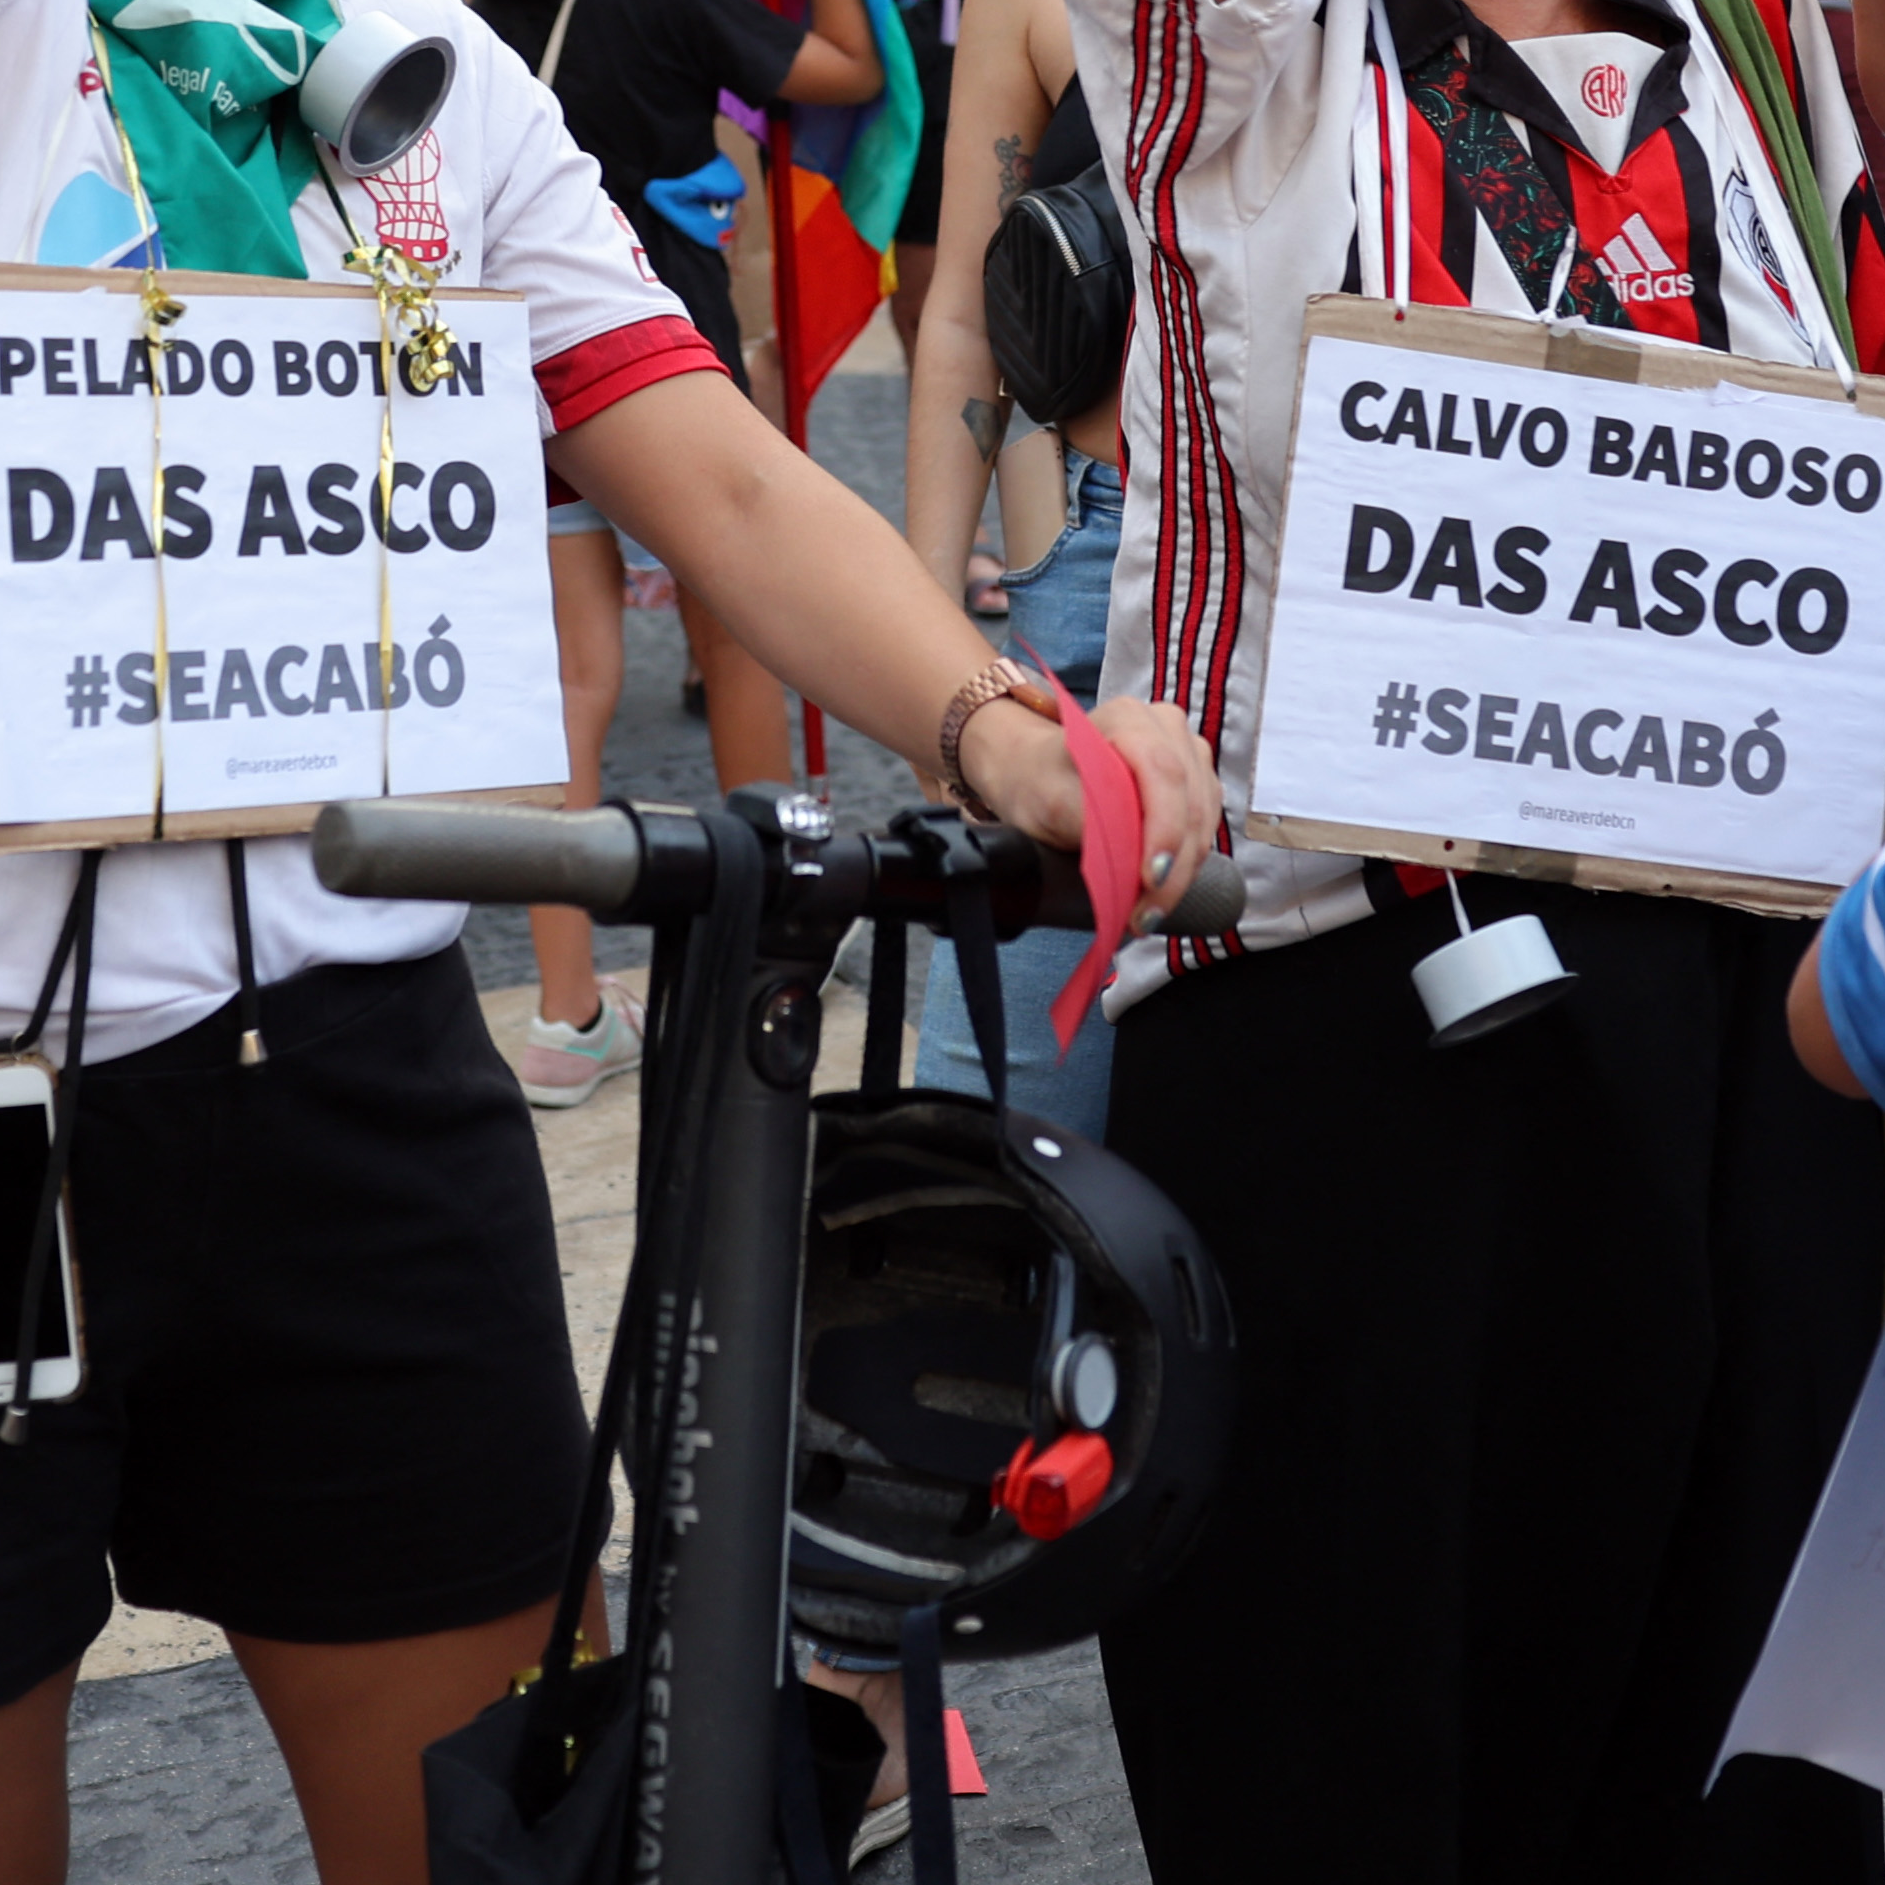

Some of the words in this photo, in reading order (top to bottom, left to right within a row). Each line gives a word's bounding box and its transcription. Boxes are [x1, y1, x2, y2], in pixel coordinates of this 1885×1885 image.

[159, 59, 211, 96] legal
[1340, 381, 1569, 468] CALVO
[1589, 416, 1882, 514] BABOSO
[7, 463, 213, 562] DAS
[238, 461, 496, 557] ASCO
[1343, 503, 1551, 615] DAS
[1569, 539, 1849, 654] ASCO
[66, 614, 465, 729] #SEACABÓ
[226, 754, 338, 778] @mareaverdebcn
[1373, 681, 1786, 796] #SEACABÓ
[1518, 801, 1636, 831] @mareaverdebcn
